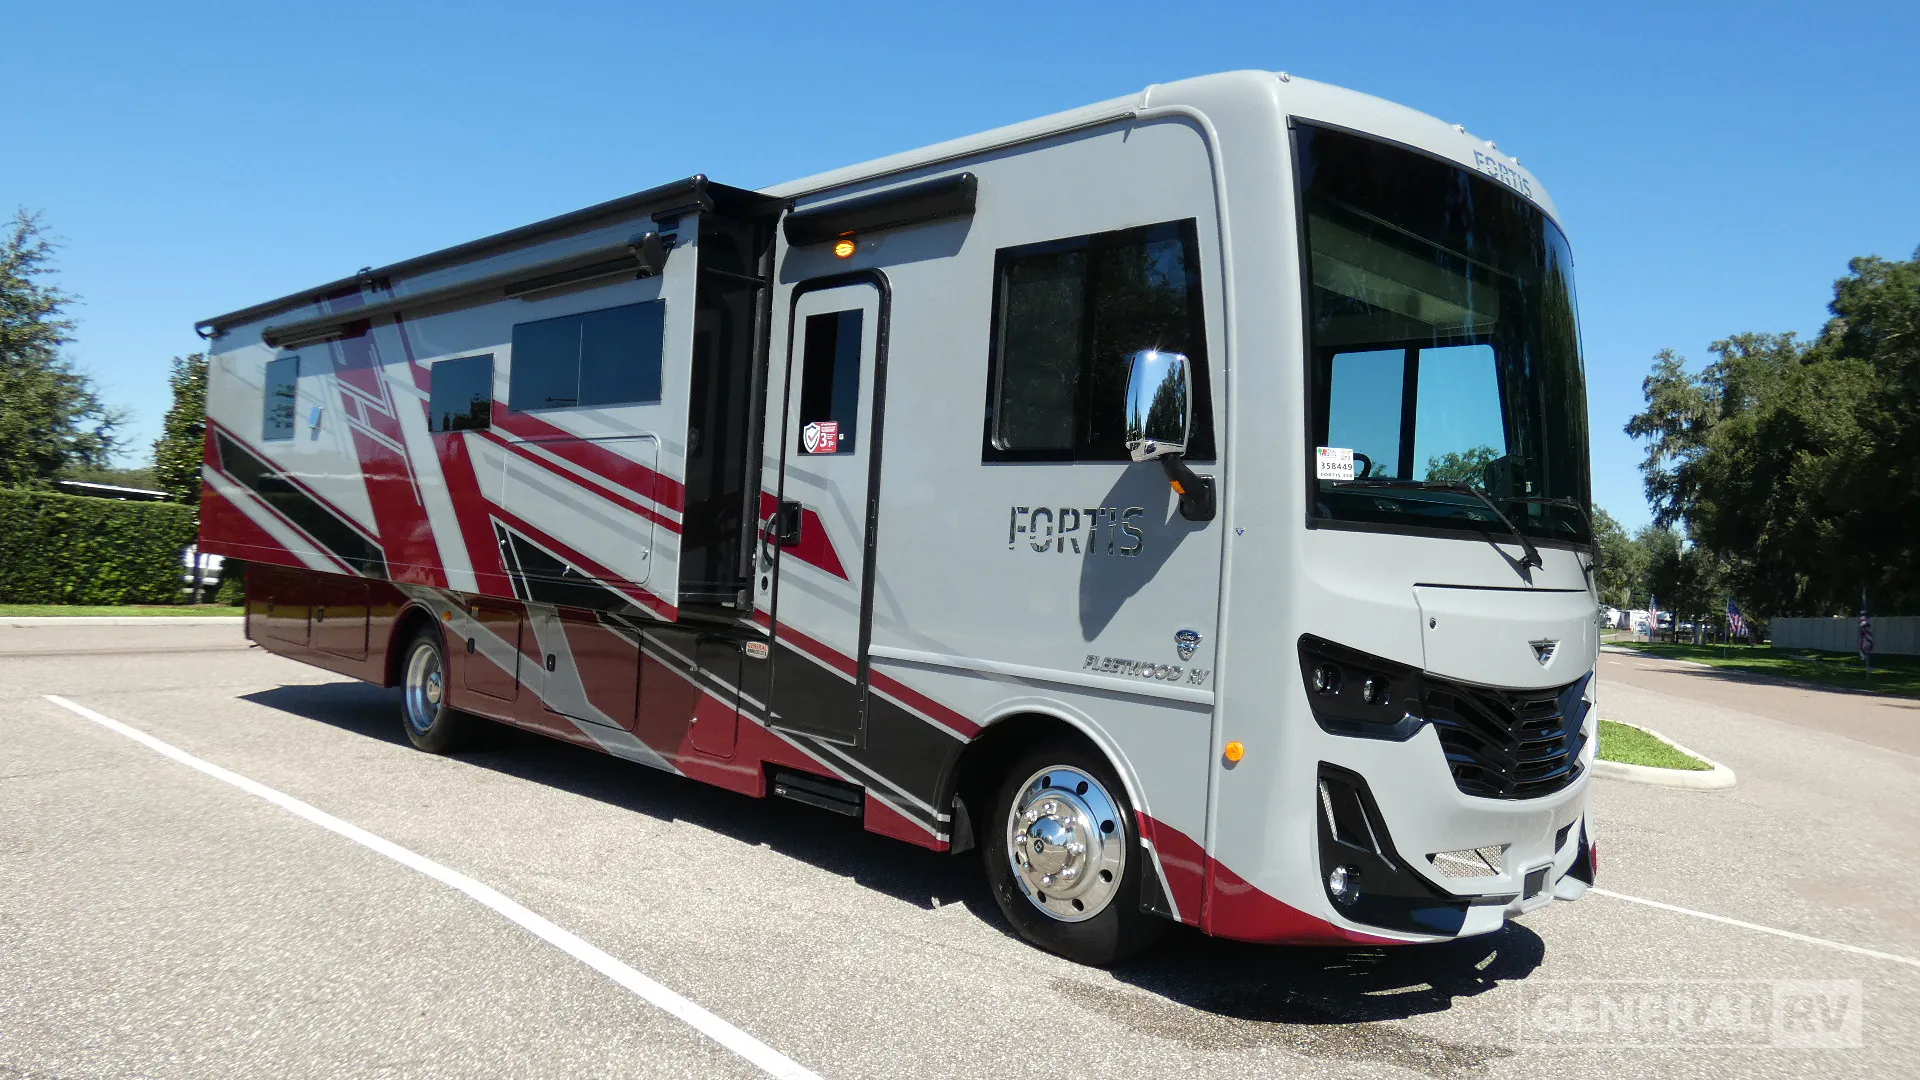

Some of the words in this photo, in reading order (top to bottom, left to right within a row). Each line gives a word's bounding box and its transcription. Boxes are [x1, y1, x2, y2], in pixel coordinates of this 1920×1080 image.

[1473, 150, 1532, 198] FORTIS
[1321, 461, 1352, 470] 358449
[1009, 506, 1144, 557] FORTIS
[1083, 655, 1183, 681] FLEETWOOD
[1187, 668, 1210, 685] RV
